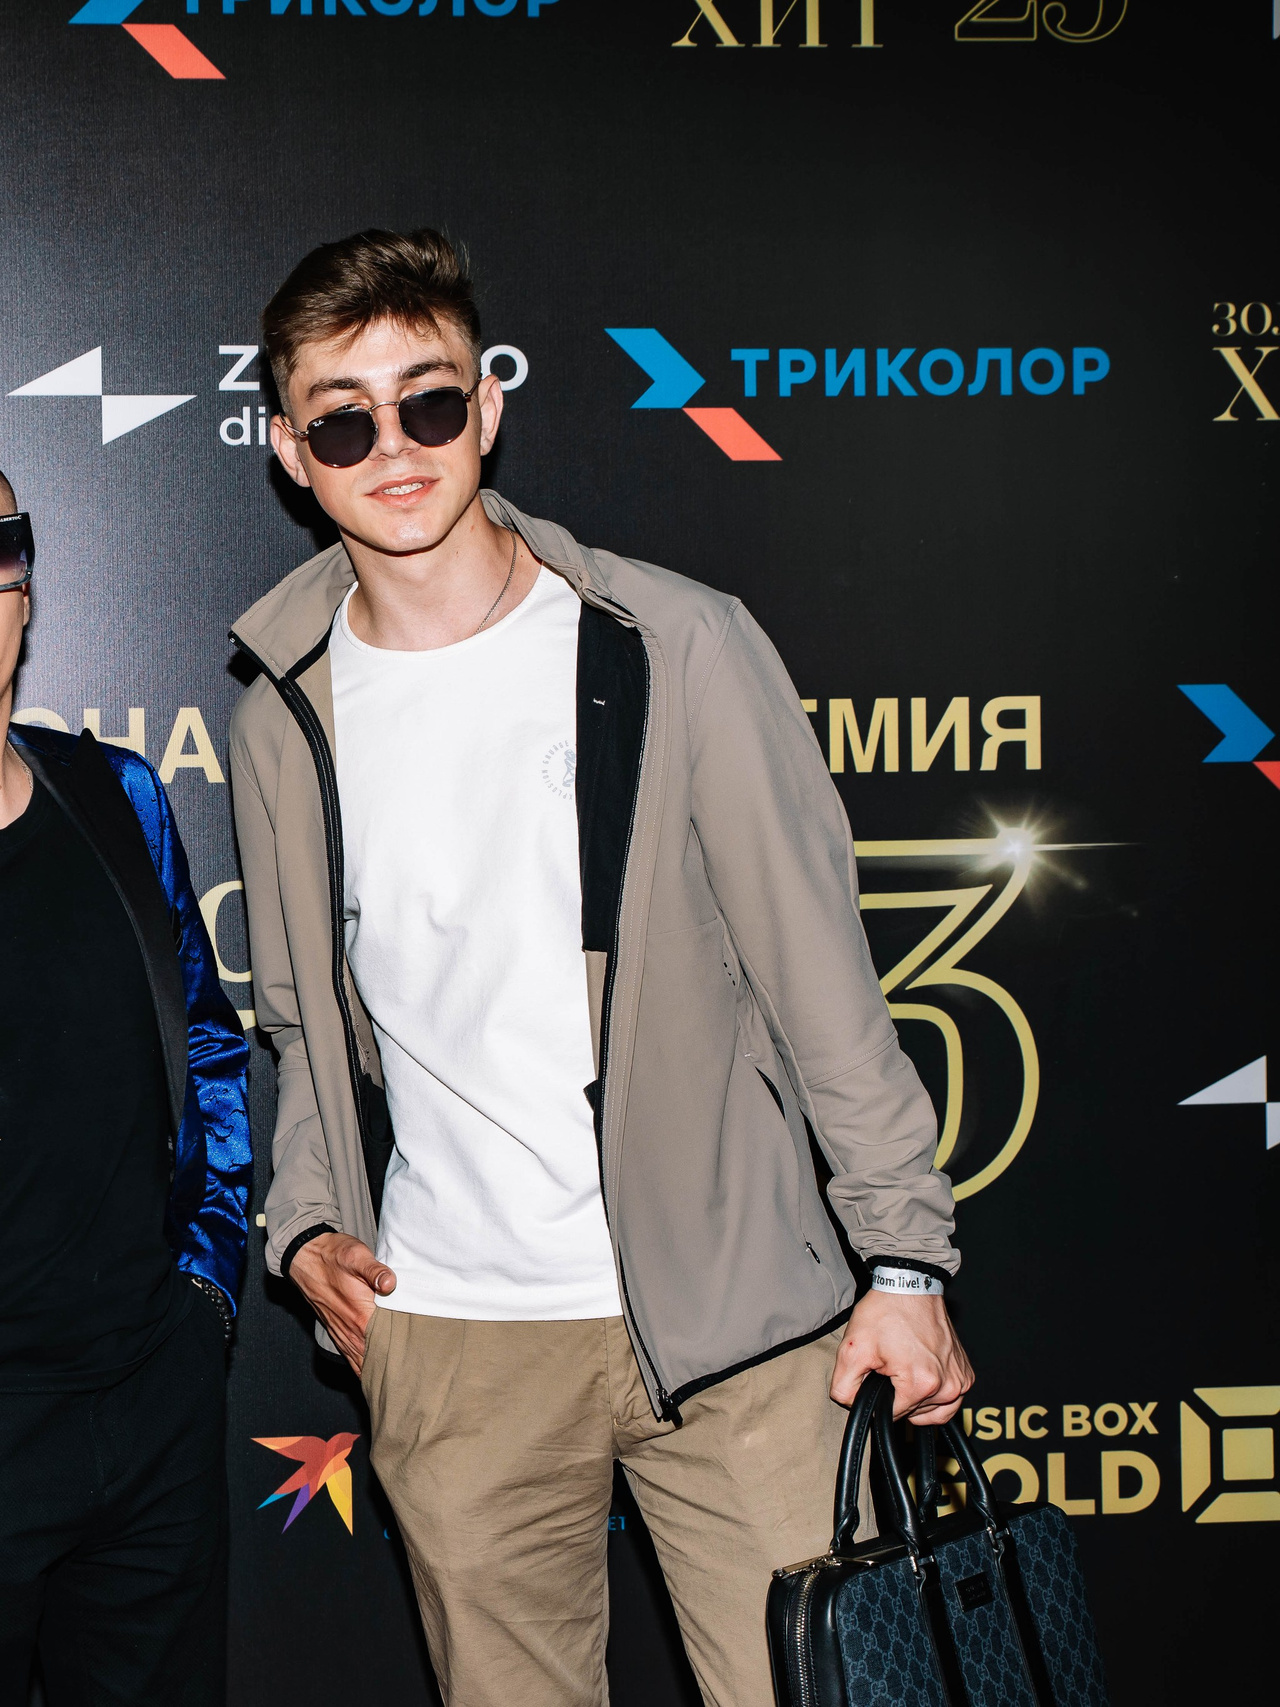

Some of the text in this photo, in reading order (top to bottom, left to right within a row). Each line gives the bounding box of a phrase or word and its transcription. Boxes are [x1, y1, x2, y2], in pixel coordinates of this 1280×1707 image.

[730, 347, 1111, 398] ТРИКОЛОР
[800, 695, 1042, 774] МИЯ
[541, 769, 573, 801] XPLOSION
[898, 1276, 921, 1289] live!
[961, 1401, 1159, 1441] SIC BOX
